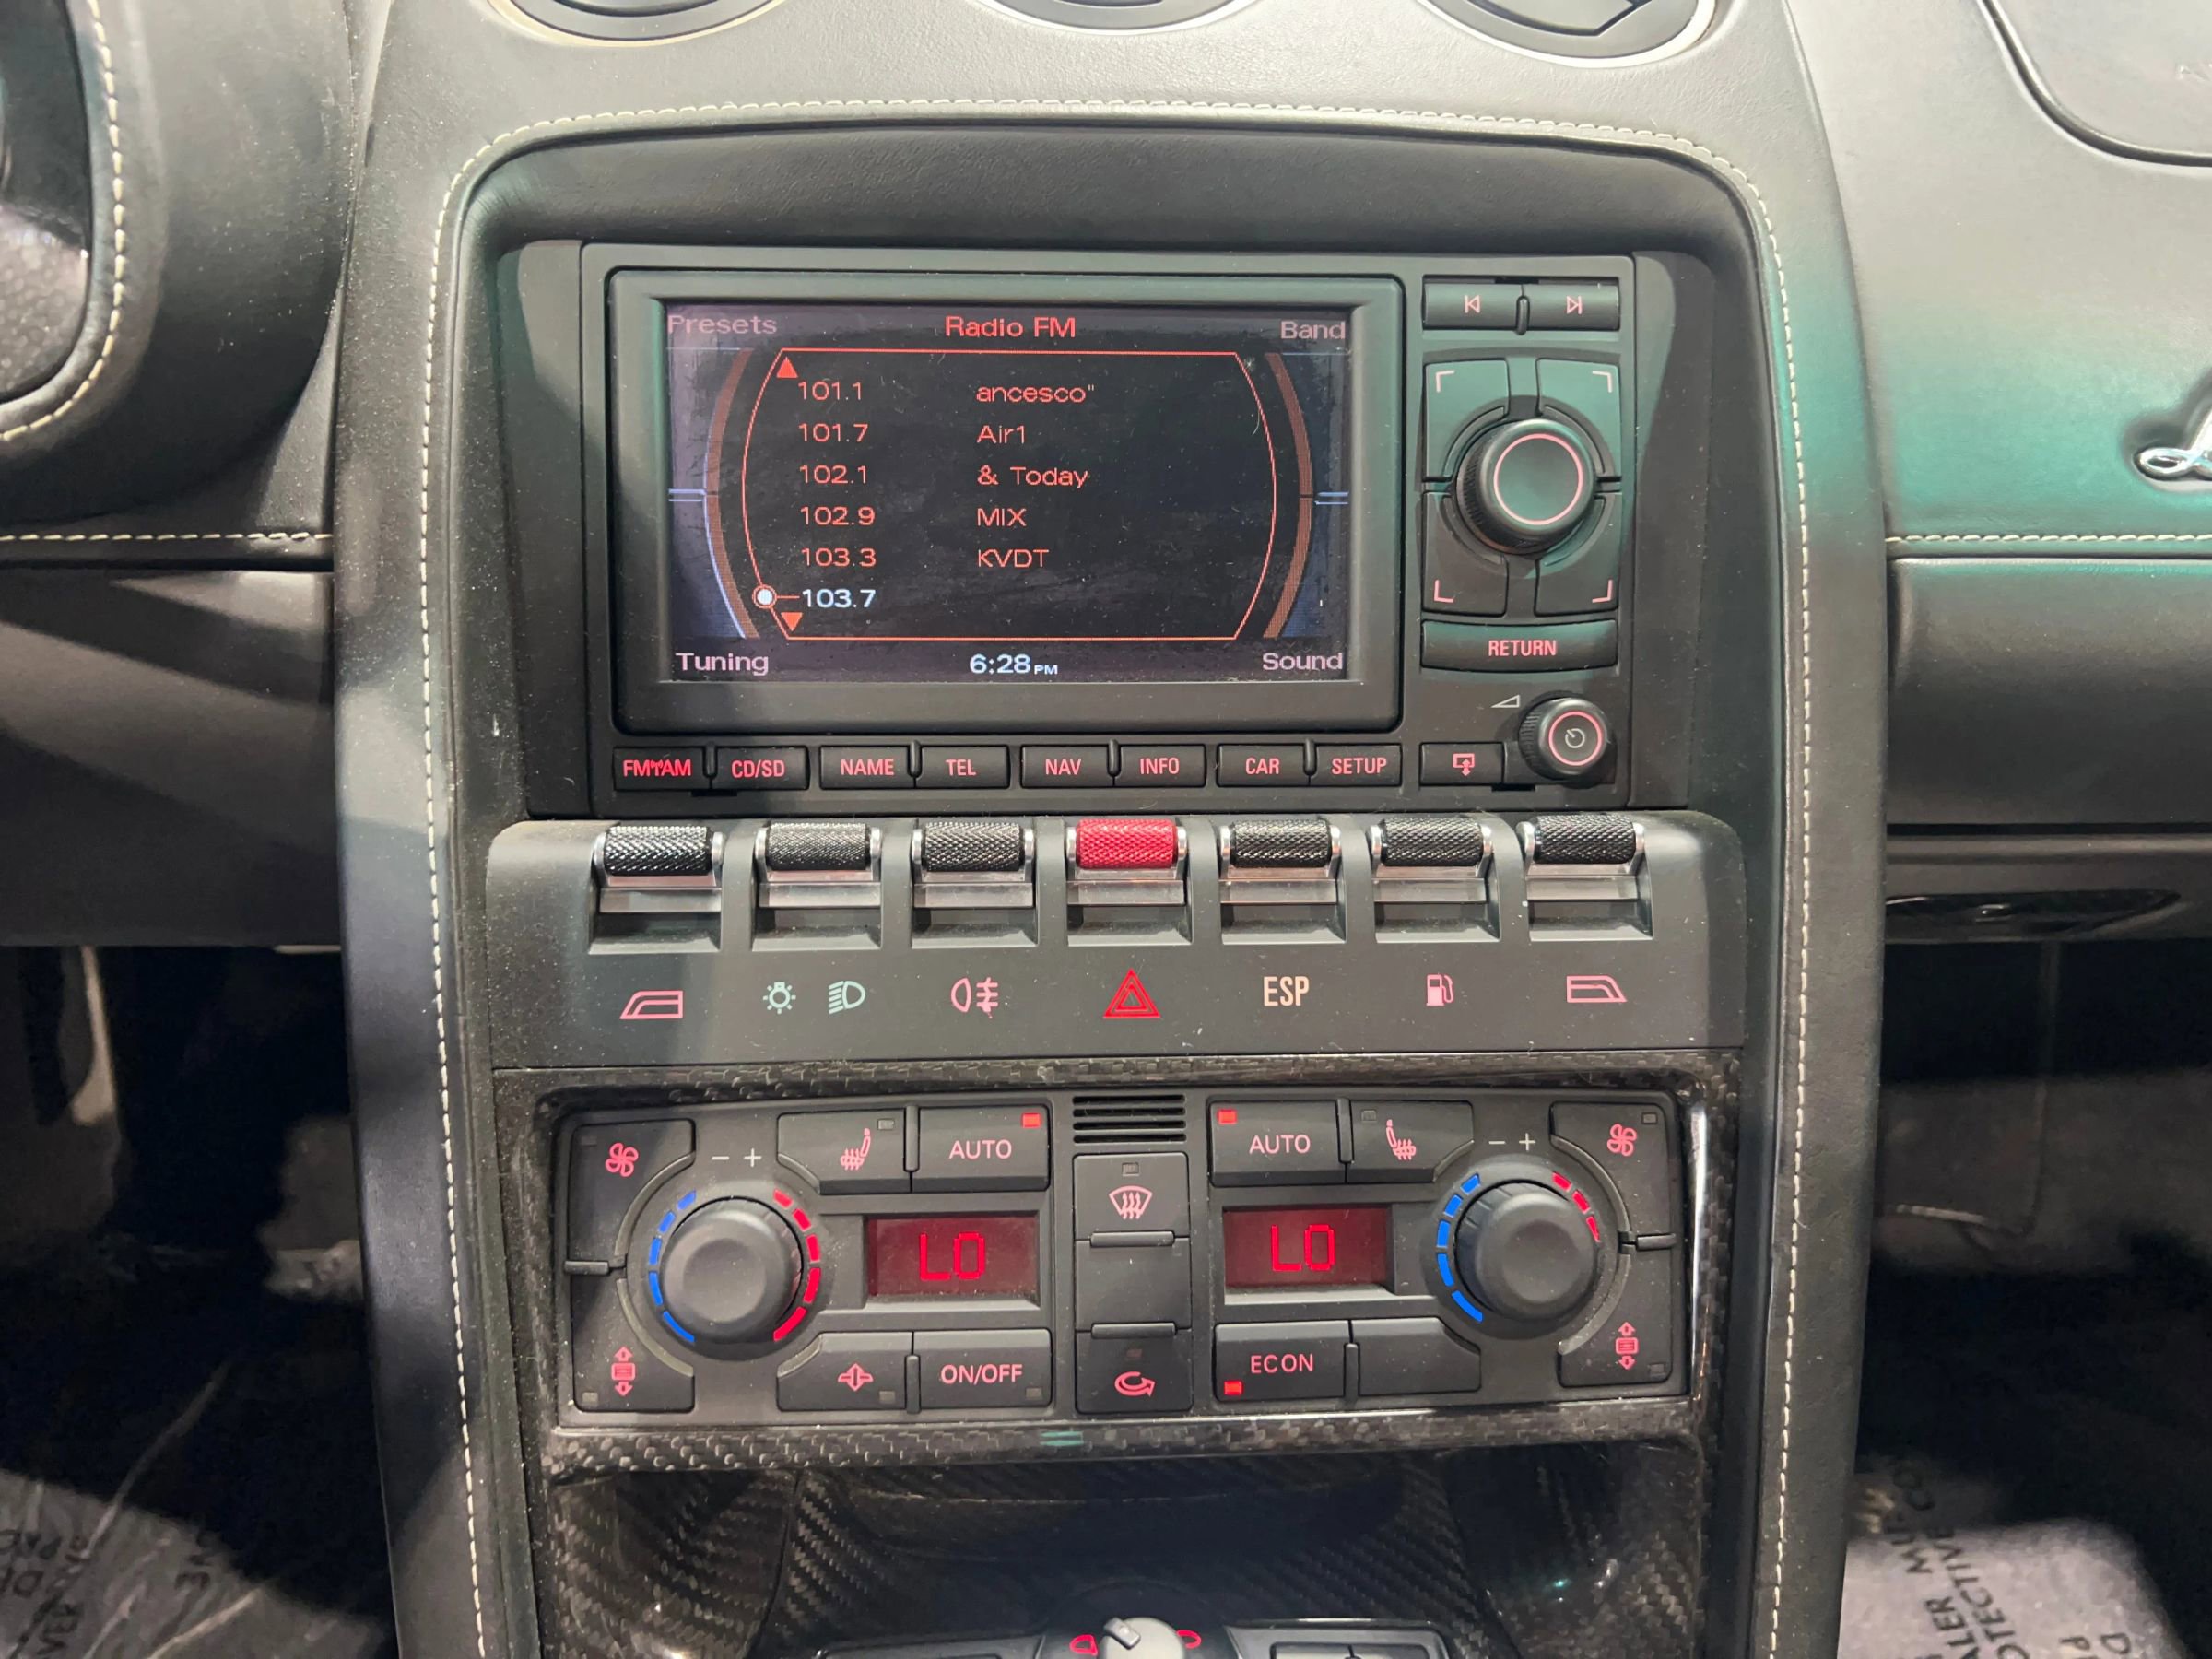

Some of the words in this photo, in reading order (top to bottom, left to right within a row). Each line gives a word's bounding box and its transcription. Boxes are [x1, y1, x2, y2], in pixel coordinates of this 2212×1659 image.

[667, 314, 777, 335] Presets
[945, 316, 1024, 337] Radio
[1033, 317, 1077, 338] FM
[1280, 320, 1347, 340] Band
[798, 381, 863, 401] 101.1
[976, 383, 1096, 403] ancesco"
[798, 423, 868, 443] 101.7
[977, 424, 1026, 444] Air1
[799, 465, 867, 485] 102.1
[978, 465, 999, 486] &
[1010, 466, 1088, 488] Today
[800, 506, 877, 526] 102.9
[977, 508, 1028, 527] MIX
[801, 547, 877, 568] 103.3
[977, 549, 1050, 569] KVDT
[802, 588, 877, 609] 103.7
[1488, 640, 1557, 657] RETURN
[676, 653, 770, 677] Tuning
[969, 653, 1031, 676] 6:28
[1262, 653, 1343, 671] Sound
[731, 759, 785, 779] CD/SD
[840, 759, 895, 776] NAME
[946, 759, 977, 776] TEL
[1044, 758, 1082, 775] NAV
[1139, 758, 1180, 775] INFO
[1245, 757, 1280, 775] CAR
[1331, 757, 1388, 775] SETUP
[1263, 975, 1310, 1006] ESP
[948, 1139, 1013, 1160] AUTO
[1249, 1135, 1312, 1155] AUTO
[918, 1231, 986, 1281] LO
[1270, 1223, 1335, 1272] LO
[940, 1363, 1023, 1385] ON/OFF
[1250, 1354, 1314, 1374] ECON
